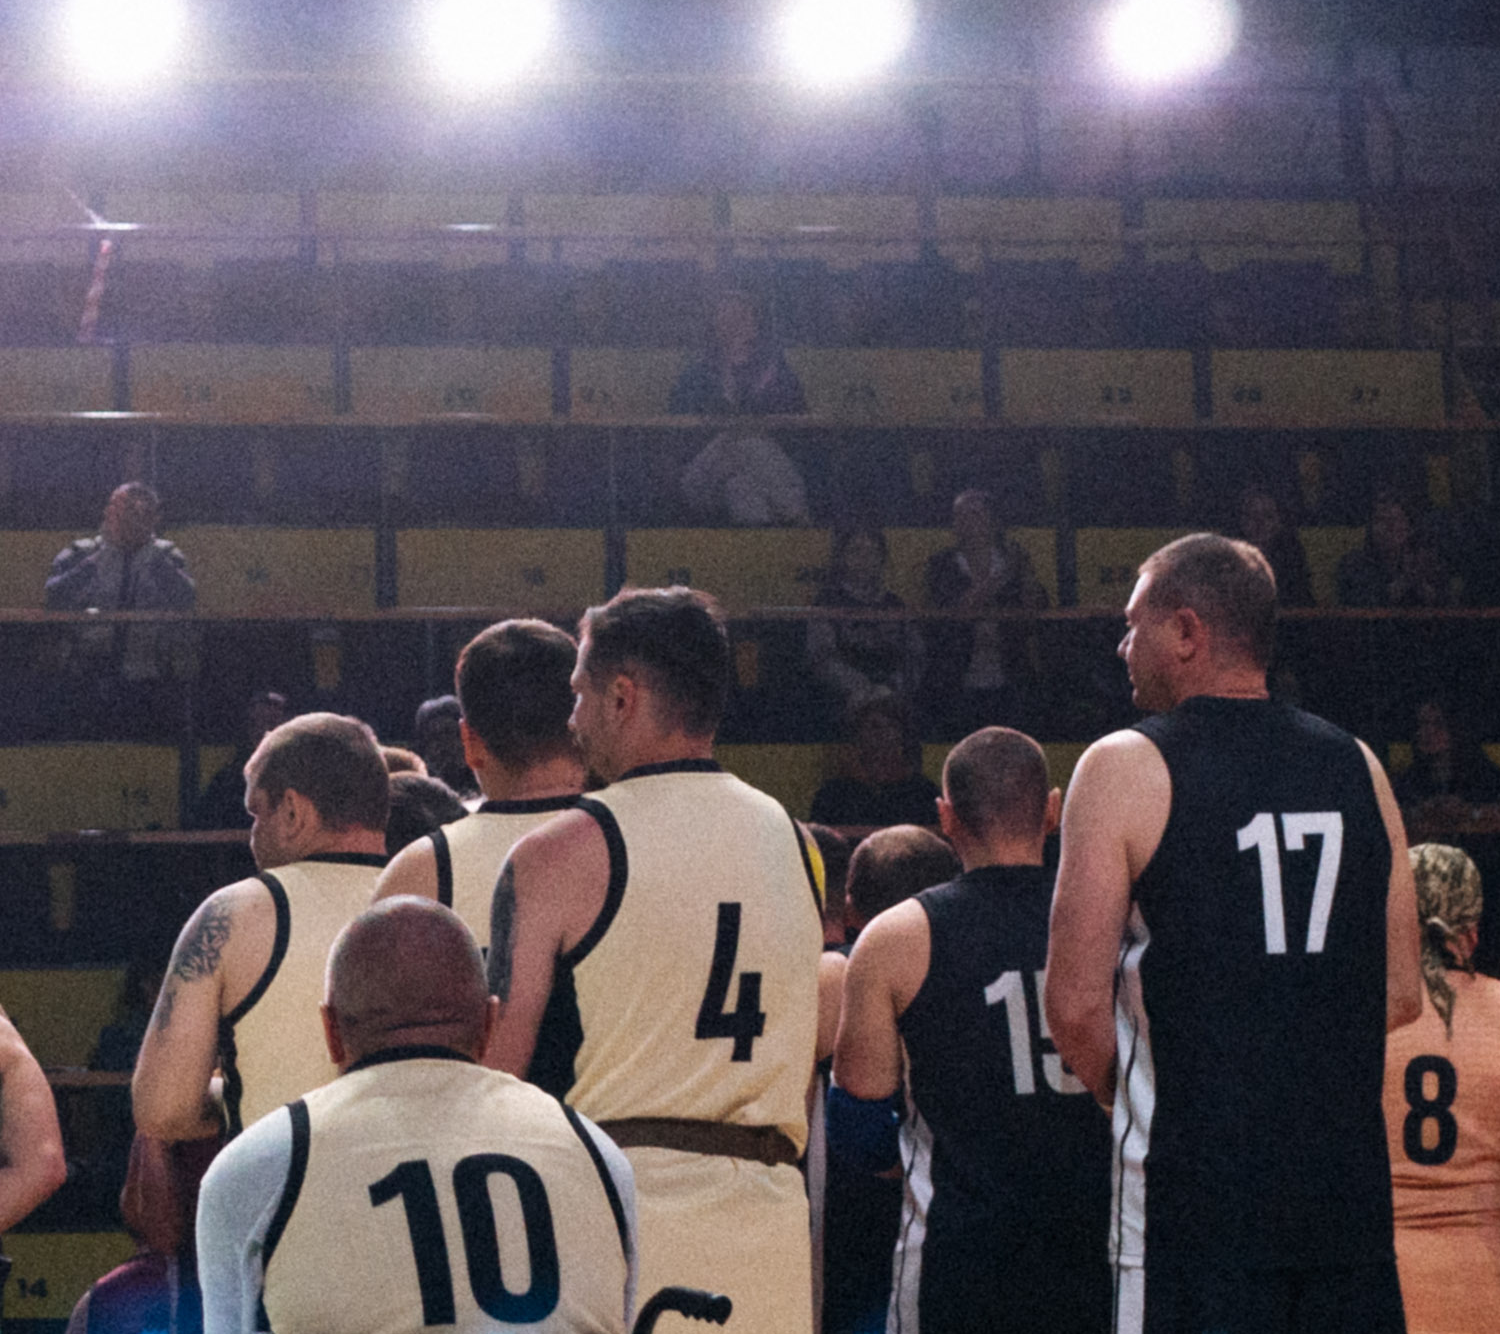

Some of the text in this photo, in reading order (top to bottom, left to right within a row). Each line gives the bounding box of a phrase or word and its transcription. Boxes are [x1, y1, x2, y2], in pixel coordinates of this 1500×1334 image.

[1236, 811, 1345, 956] 17
[694, 902, 767, 1063] 4
[1402, 1055, 1459, 1167] 8
[16, 1276, 50, 1300] 14
[367, 1153, 560, 1327] 10
